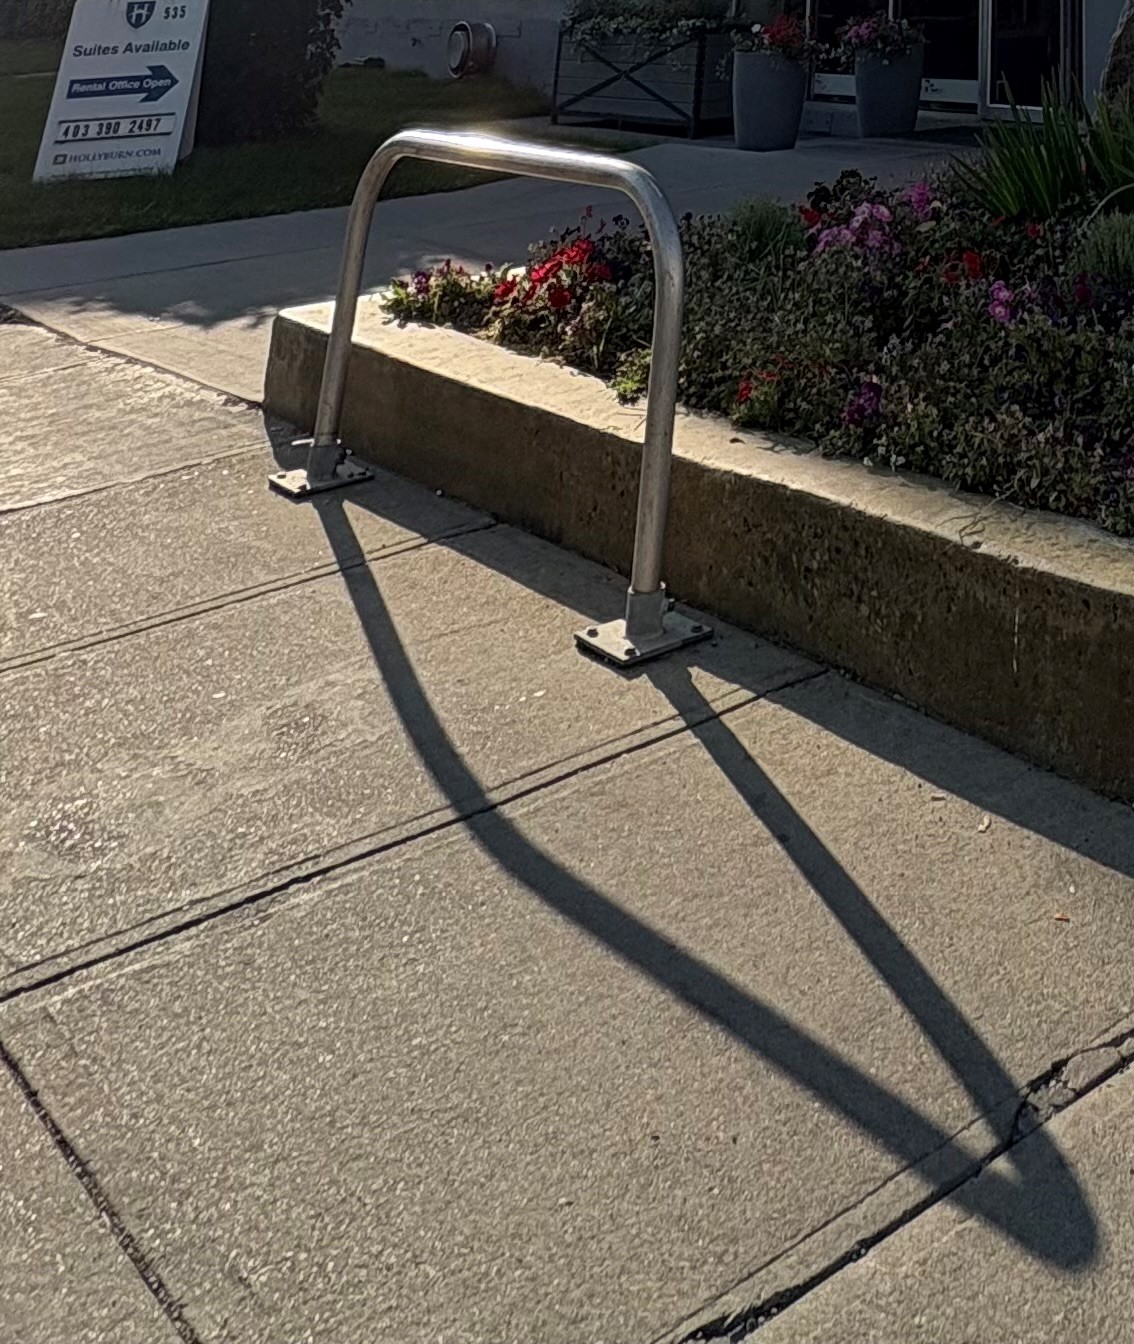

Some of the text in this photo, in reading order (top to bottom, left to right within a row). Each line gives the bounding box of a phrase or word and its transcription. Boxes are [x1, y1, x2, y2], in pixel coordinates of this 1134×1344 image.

[163, 5, 187, 19] 535
[72, 39, 190, 57] Suites Available
[71, 78, 172, 93] Rental Office Open
[62, 125, 89, 138] 403
[128, 118, 162, 133] 2497
[68, 148, 161, 163] HOLLYBURN.COM
